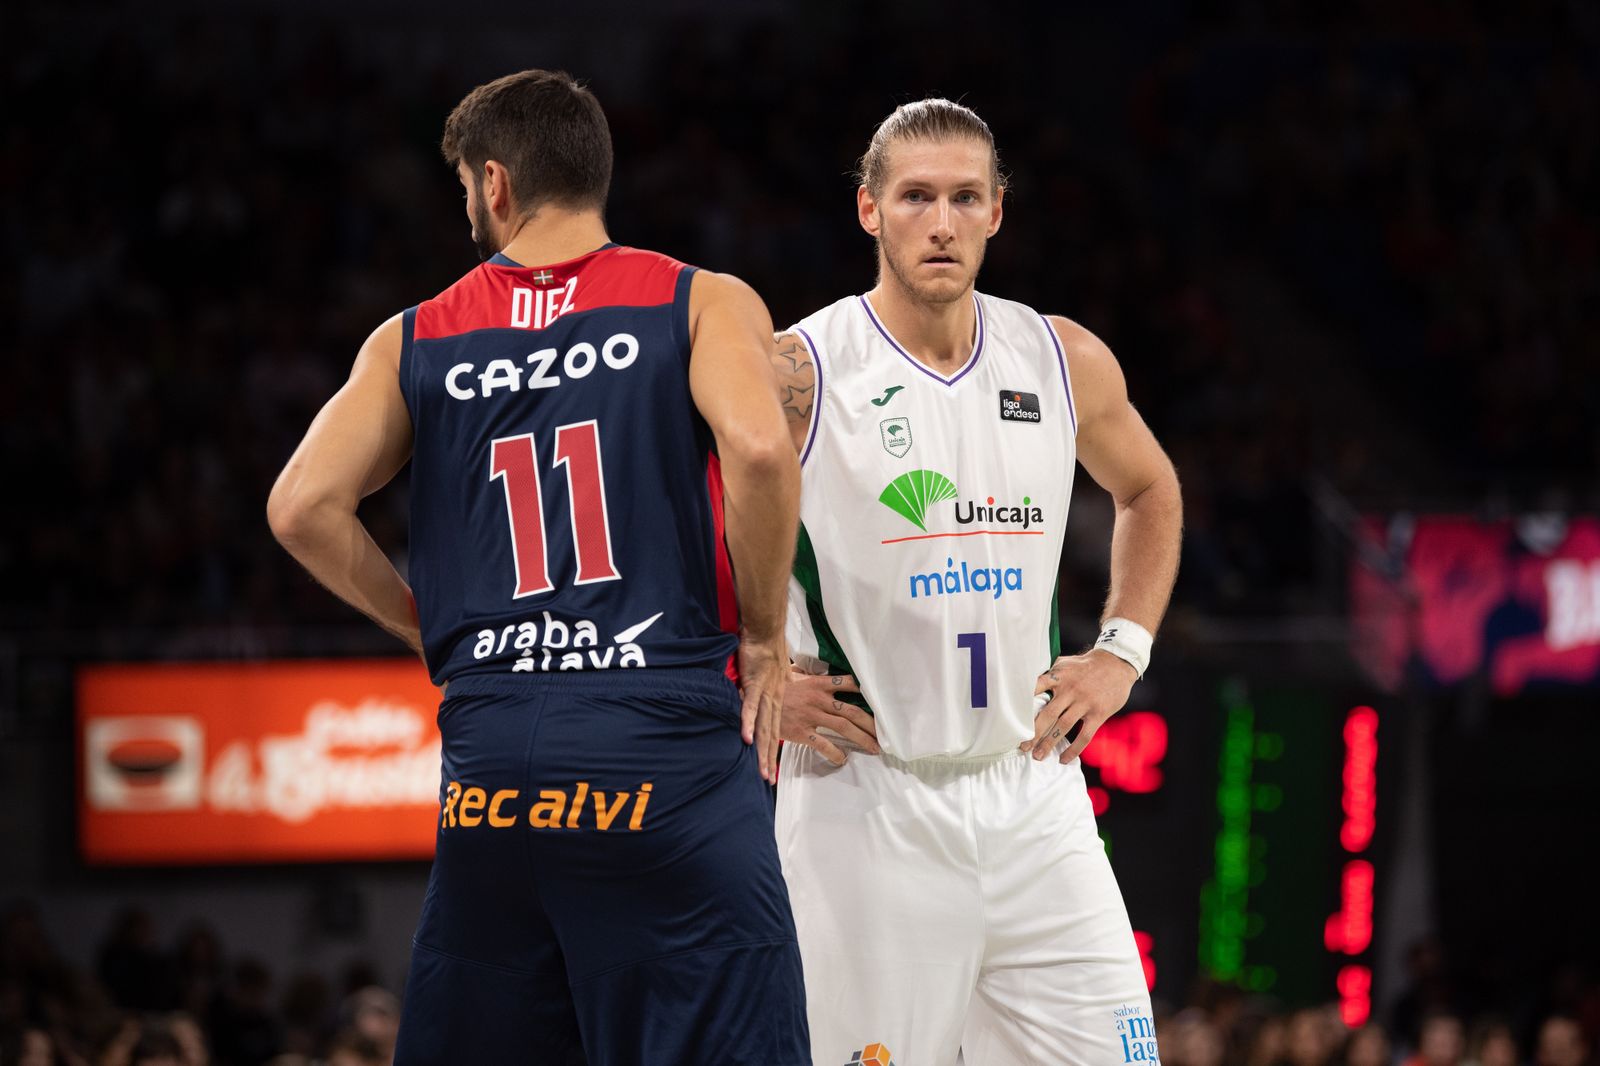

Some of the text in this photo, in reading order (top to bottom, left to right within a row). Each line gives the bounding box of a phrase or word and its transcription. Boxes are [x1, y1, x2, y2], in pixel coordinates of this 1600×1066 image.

[510, 276, 578, 329] DIEZ
[445, 333, 640, 401] CAZOO
[1003, 398, 1020, 410] liga
[1003, 409, 1039, 420] endesa
[489, 419, 622, 600] 11
[955, 496, 1044, 530] Unicaja
[909, 557, 1023, 600] málaga
[473, 611, 598, 660] araba
[957, 632, 988, 708] 1
[1113, 1003, 1141, 1018] sabor
[1116, 1019, 1125, 1031] a
[1120, 1033, 1158, 1066] lag
